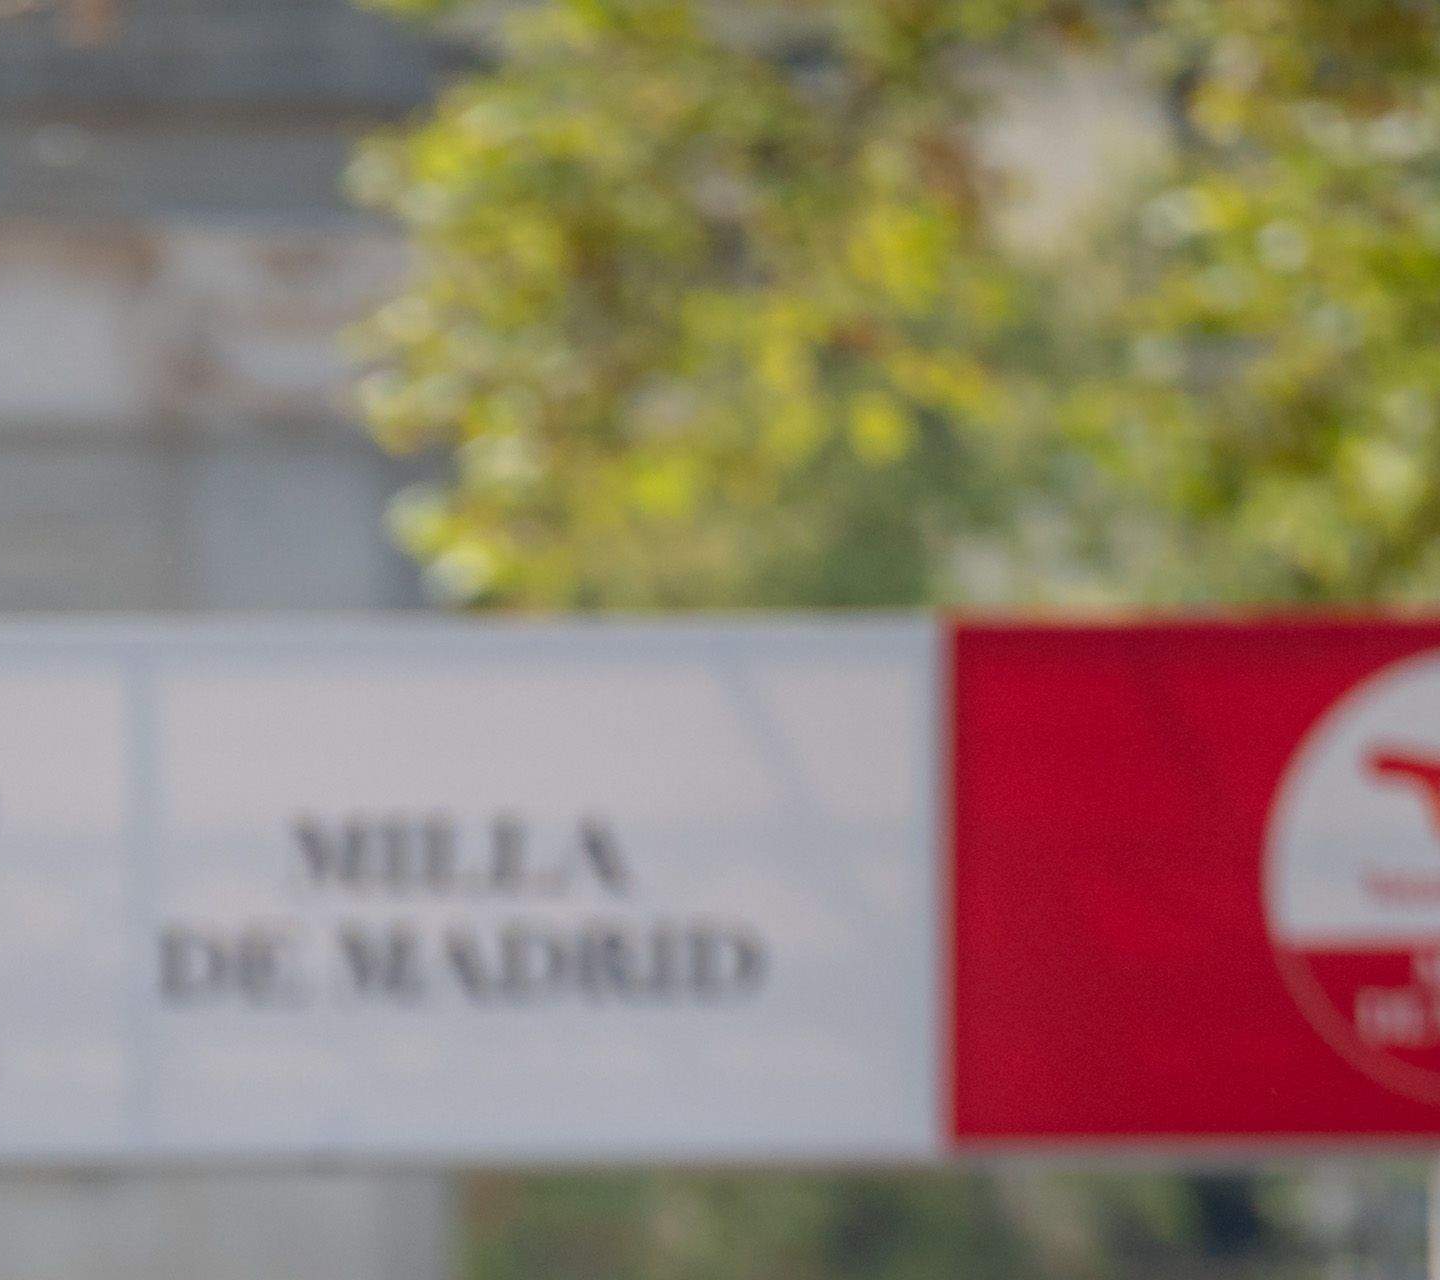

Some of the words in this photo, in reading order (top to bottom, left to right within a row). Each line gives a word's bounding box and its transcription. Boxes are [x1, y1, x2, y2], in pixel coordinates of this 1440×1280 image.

[288, 808, 634, 894] MILLA
[158, 920, 302, 1003] DE
[338, 920, 772, 1003] MADRID
